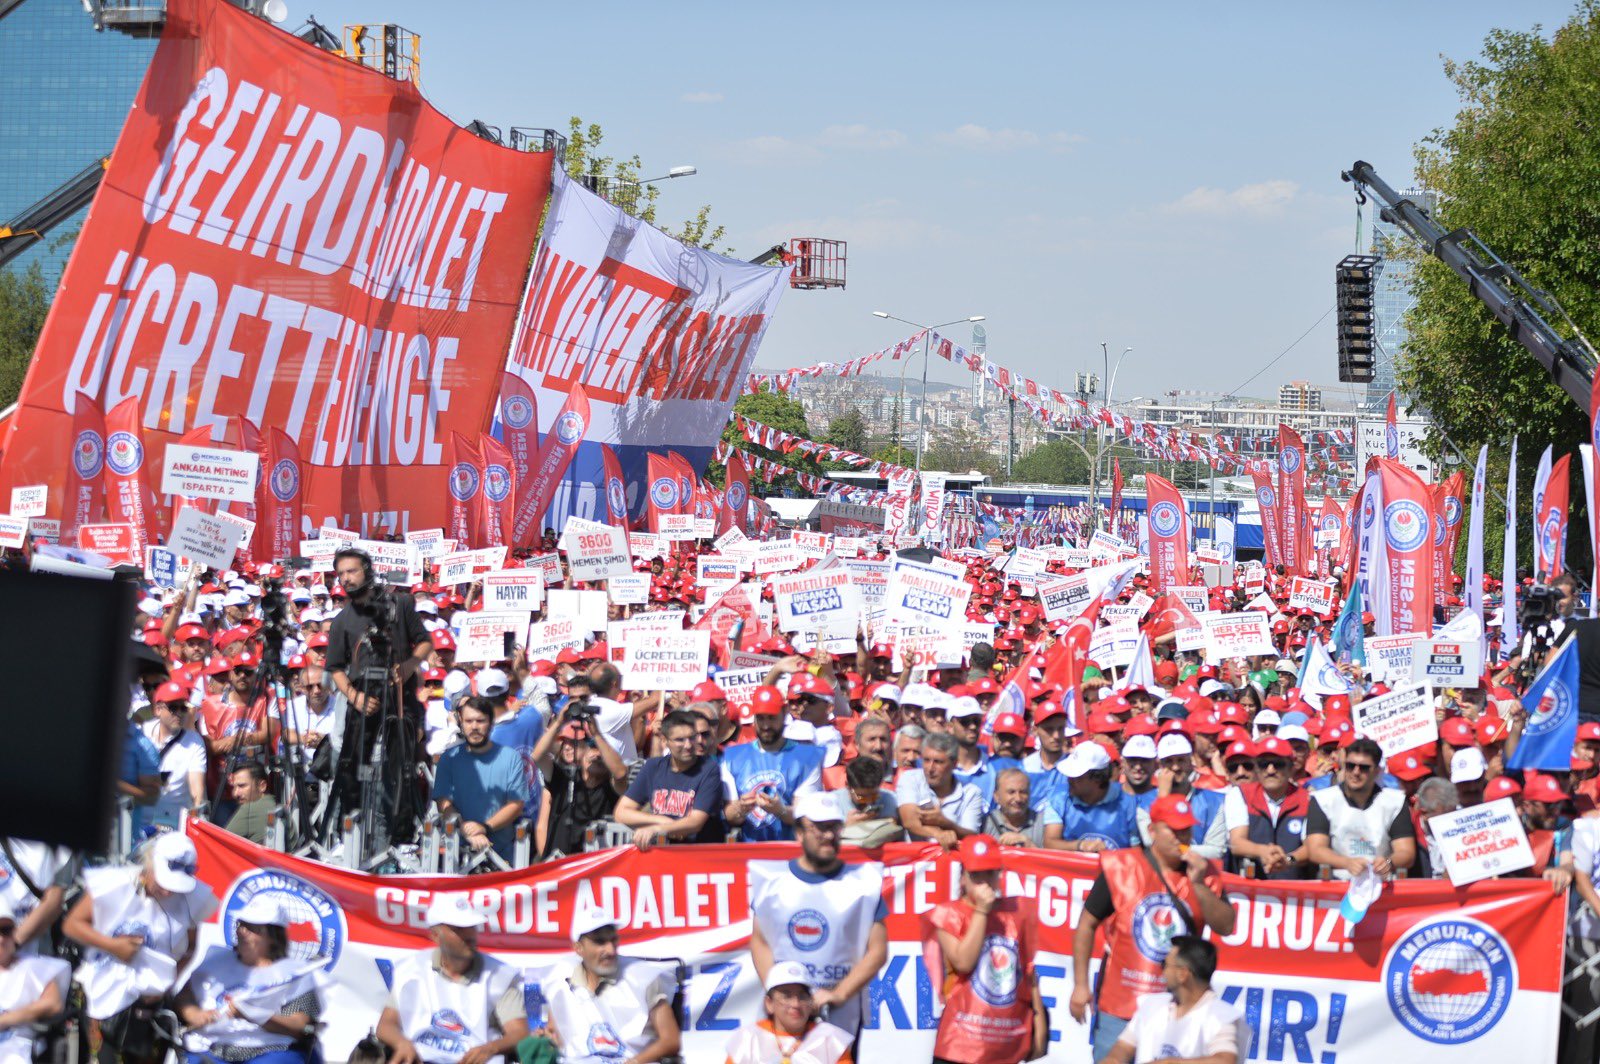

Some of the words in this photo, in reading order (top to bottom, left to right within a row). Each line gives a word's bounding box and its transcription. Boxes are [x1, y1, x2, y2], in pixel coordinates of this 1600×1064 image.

[143, 67, 404, 289] GELİRDE
[364, 157, 508, 312] ADALET
[64, 250, 355, 465] ÜCRETTE
[334, 322, 459, 466] DENGE
[635, 305, 765, 403] ADALET
[1365, 428, 1414, 439] Malpe
[201, 454, 233, 462] MEMUR-SEN
[172, 462, 211, 474] ANKARA
[213, 467, 249, 478] MİTİNGİ
[182, 482, 225, 493] ISPARTA
[230, 487, 235, 495] 2
[926, 489, 941, 529] ÇÖZÜM
[667, 517, 687, 525] 3600
[578, 533, 612, 549] 3600
[796, 544, 824, 553] TİYORUZ
[372, 556, 408, 565] RETLERİ
[572, 558, 601, 567] HEMEN
[604, 555, 628, 566] ŞİMDİ
[758, 555, 794, 564] TÜRKİYE
[447, 564, 467, 576] HAYIR
[779, 576, 823, 594] ADALETLİ
[825, 574, 849, 587] ZAM
[901, 573, 943, 593] ADALETLİ
[944, 584, 967, 599] ZAM
[496, 585, 527, 600] HAYIR
[792, 588, 838, 602] İNSANCA
[1300, 586, 1324, 597] ZAM
[793, 596, 841, 615] YAŞAM
[1292, 593, 1330, 607] İSTİYORUZ
[904, 596, 951, 618] YAŞAM
[1105, 607, 1139, 615] TEKLİFTE
[469, 625, 489, 634] HER
[543, 621, 572, 638] 3600
[1212, 626, 1233, 635] HER
[1234, 623, 1261, 633] ŞEYE
[1216, 634, 1263, 647] DEĞER
[532, 645, 558, 655] HEMEN
[560, 641, 581, 651] ŞİMDİ
[1380, 647, 1412, 659] SADAKA
[1436, 646, 1456, 654] HAK
[634, 650, 698, 660] ÜCRETLERİ
[736, 657, 762, 666] SUSMA
[1433, 655, 1458, 664] EMEK
[631, 663, 701, 673] ARTIRILSIN
[1429, 666, 1463, 674] ADALET
[720, 670, 769, 687] TEKLİF
[741, 686, 757, 694] VİC
[653, 789, 695, 817] MAV
[1455, 810, 1493, 824] YARDIMCI
[1456, 837, 1519, 862] AKTARILSIN
[374, 881, 559, 933] GERDE
[572, 873, 734, 932] ADALET
[1204, 893, 1356, 953] ORUZ!
[1400, 925, 1504, 965] MEMUR-SEN
[805, 963, 851, 981] R-SEN
